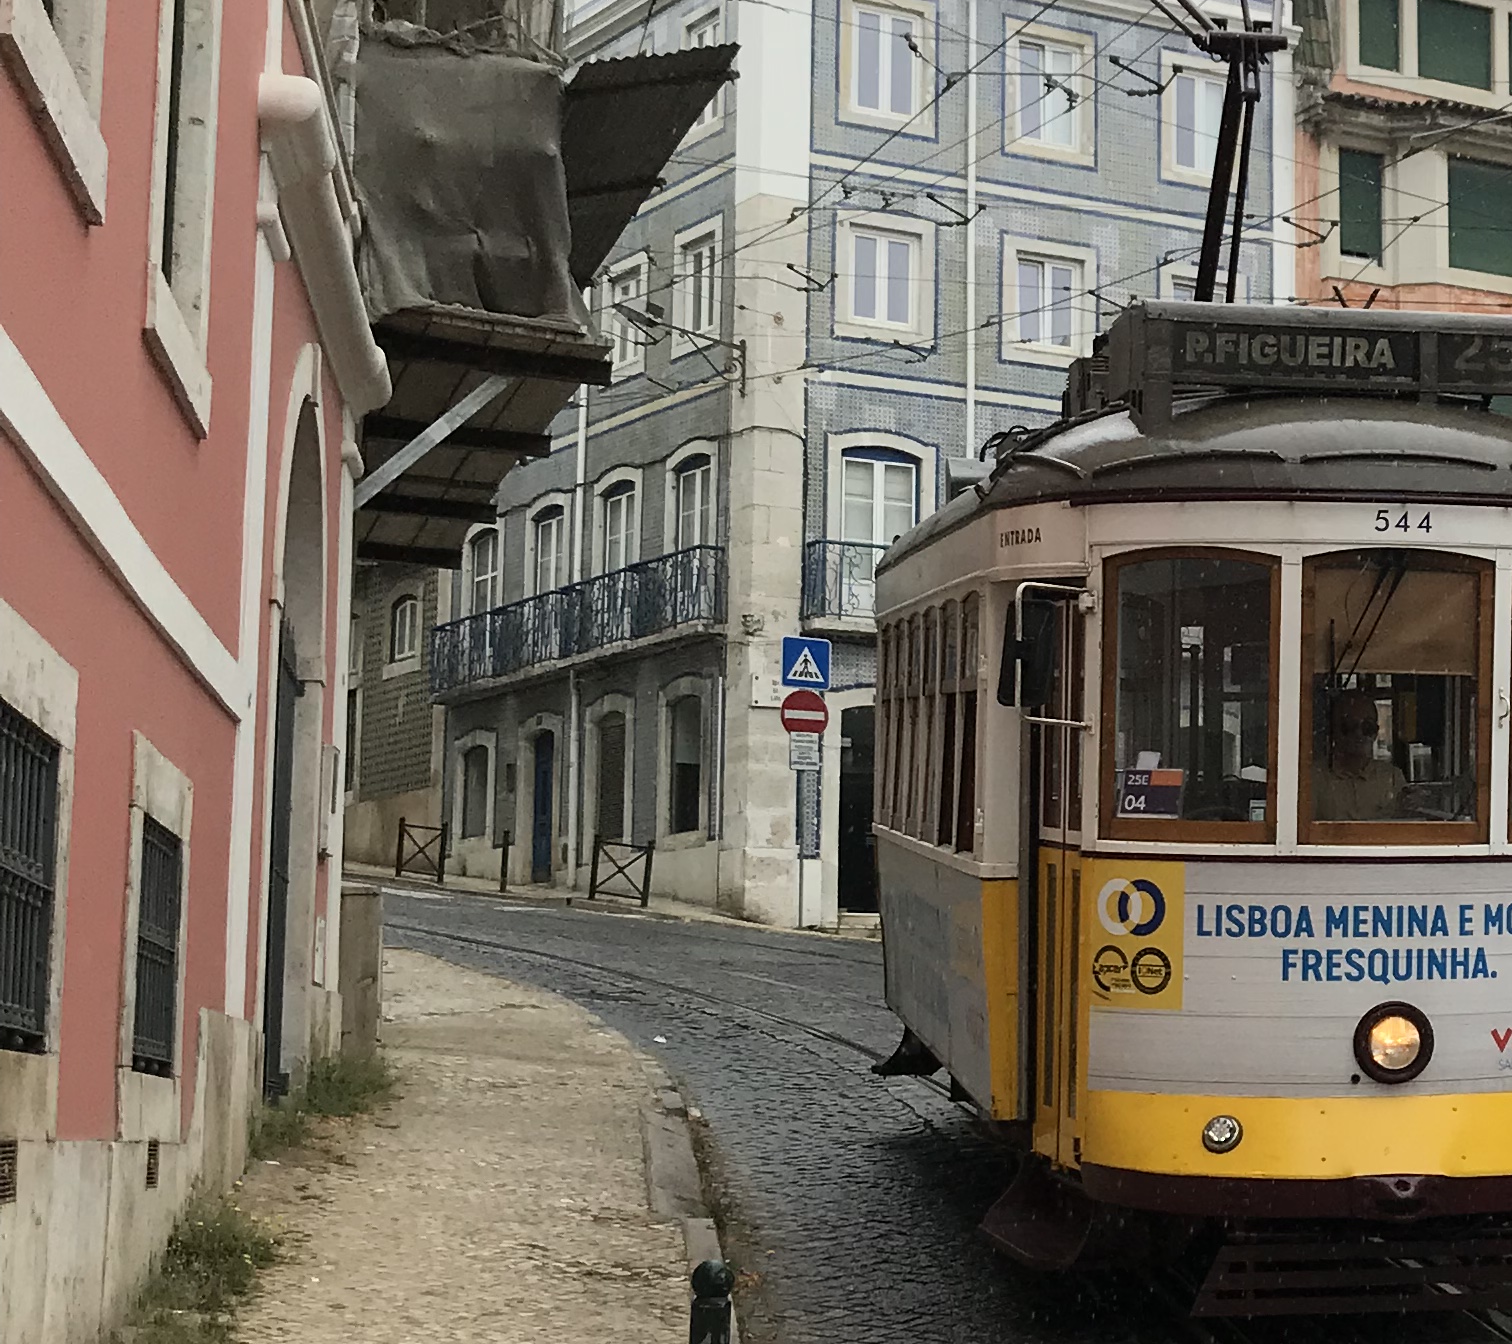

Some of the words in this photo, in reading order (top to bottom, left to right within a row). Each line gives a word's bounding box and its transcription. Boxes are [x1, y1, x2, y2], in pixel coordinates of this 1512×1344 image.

[1186, 331, 1397, 369] P.FIGUEIRA
[1374, 509, 1432, 533] 544
[1000, 527, 1041, 548] ENTRADA
[1127, 774, 1149, 786] 25E
[1124, 794, 1146, 811] 04
[1196, 904, 1316, 938] LISBOA
[1325, 904, 1450, 938] MENINA
[1459, 904, 1474, 936] E
[1281, 947, 1498, 985] FRESQUINHA.
